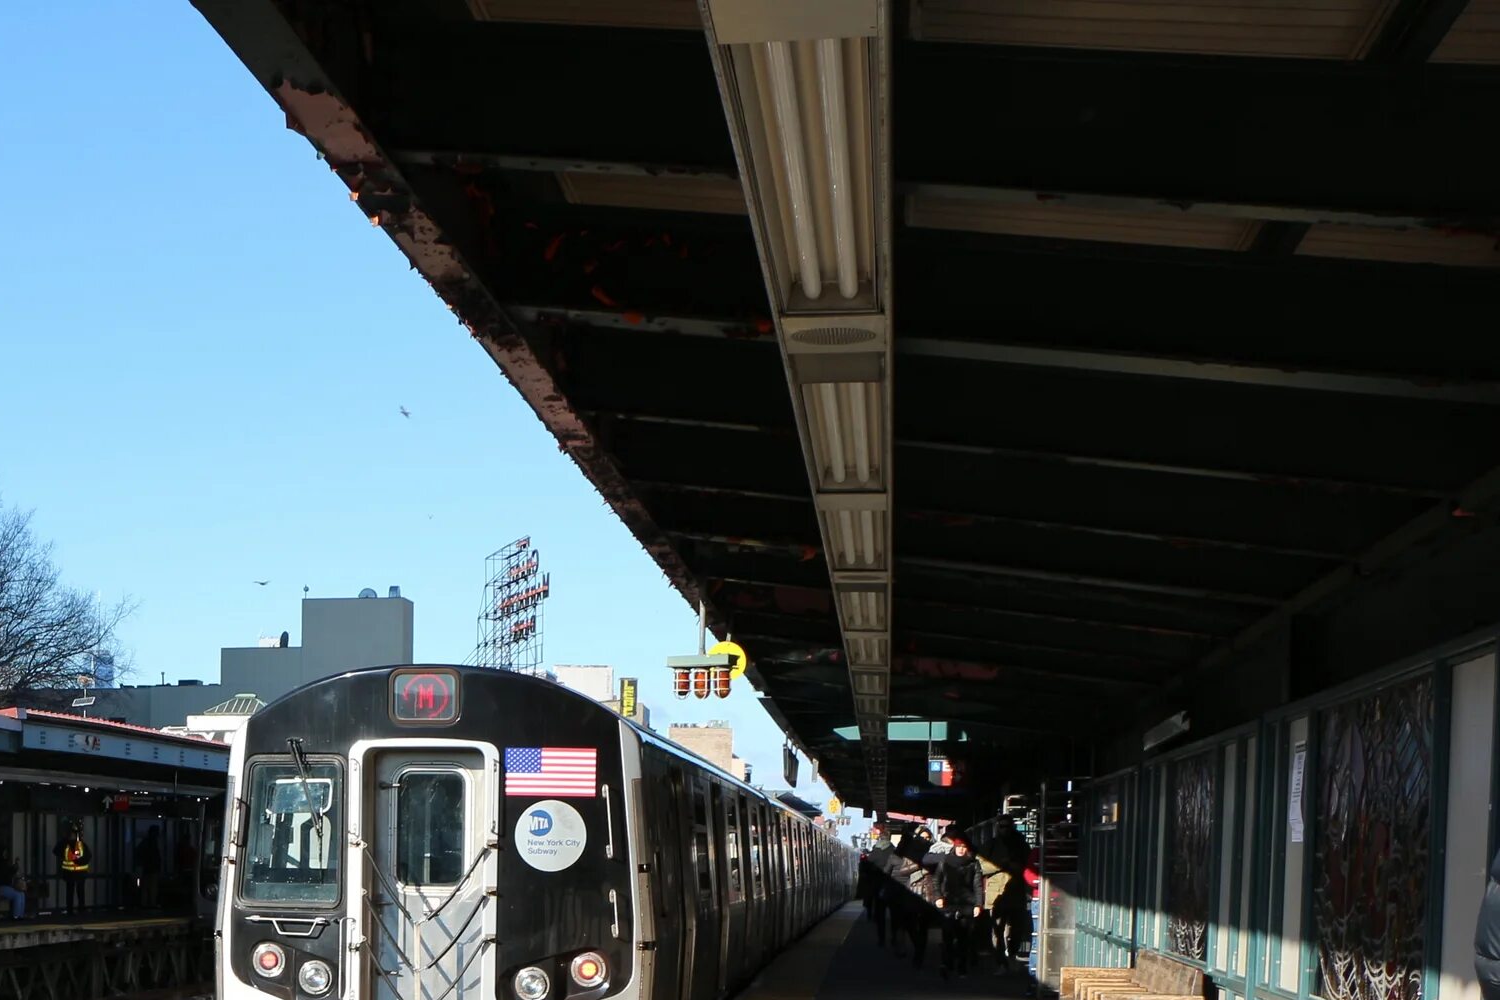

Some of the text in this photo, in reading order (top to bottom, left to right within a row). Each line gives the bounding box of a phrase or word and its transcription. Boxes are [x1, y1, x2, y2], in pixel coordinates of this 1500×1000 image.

[417, 683, 434, 709] M
[529, 815, 549, 831] MTA
[565, 839, 580, 847] City
[527, 847, 557, 856] Subway
